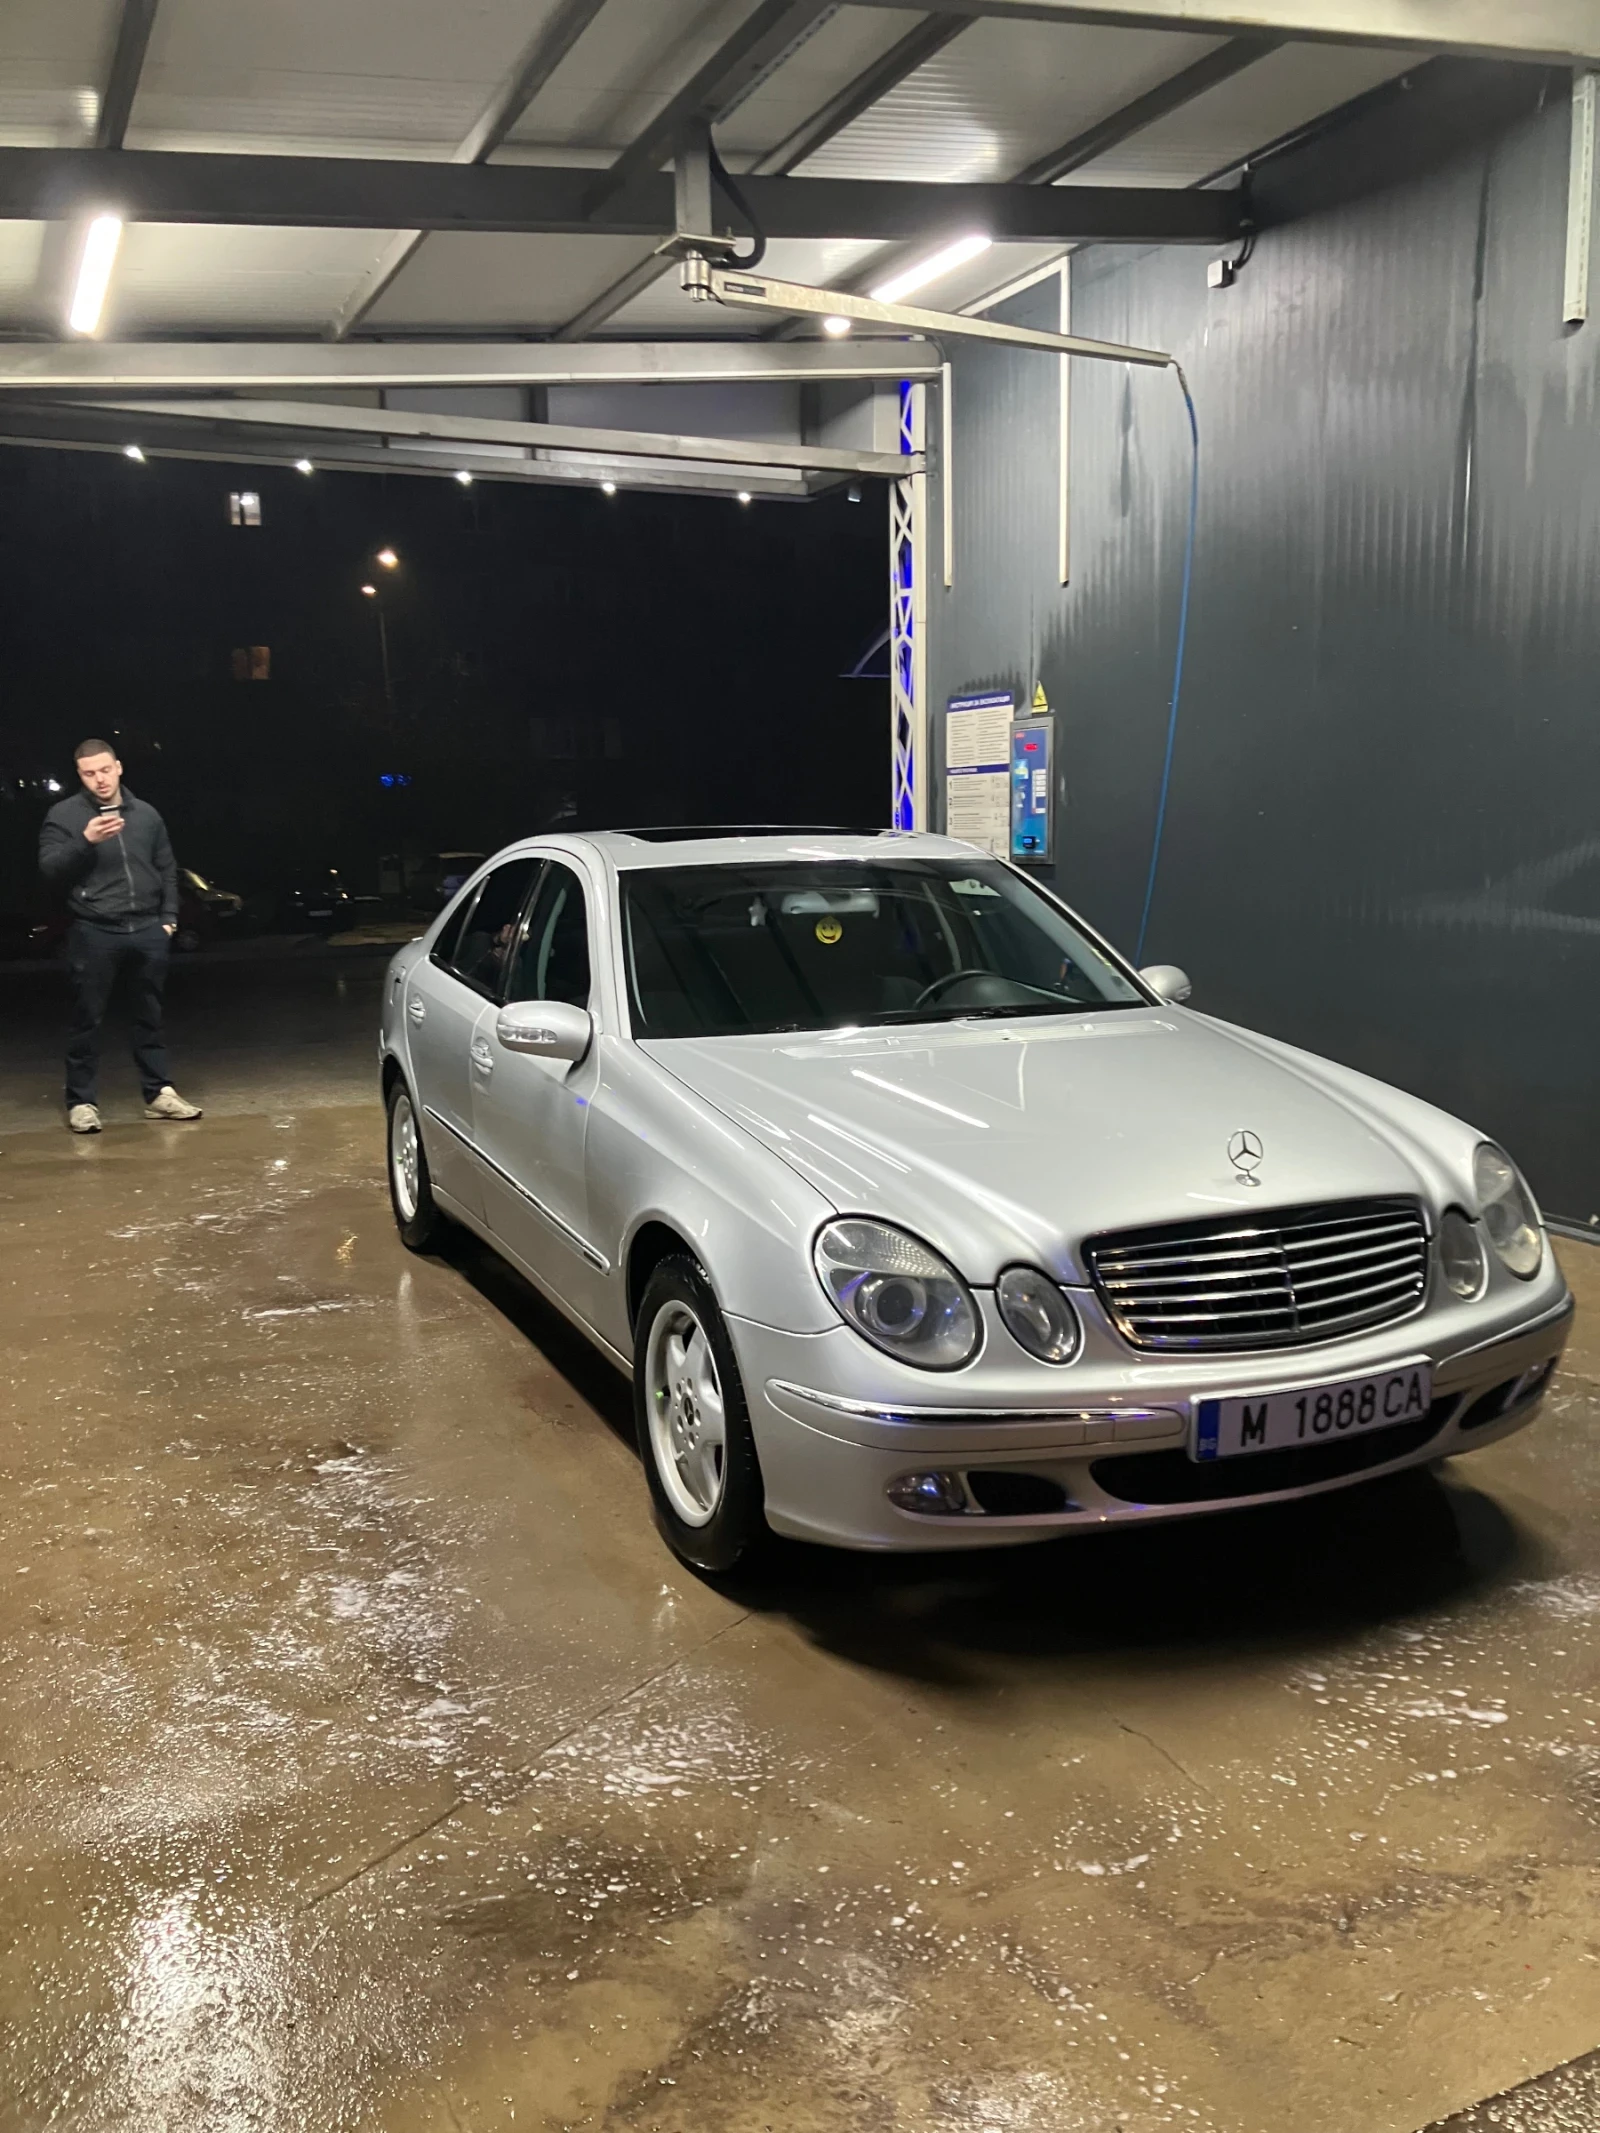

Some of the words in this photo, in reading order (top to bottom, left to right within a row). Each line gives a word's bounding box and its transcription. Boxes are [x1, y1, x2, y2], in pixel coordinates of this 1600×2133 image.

[1240, 1403, 1268, 1448] M
[1295, 1384, 1377, 1439] 1888
[1383, 1372, 1423, 1417] CA
